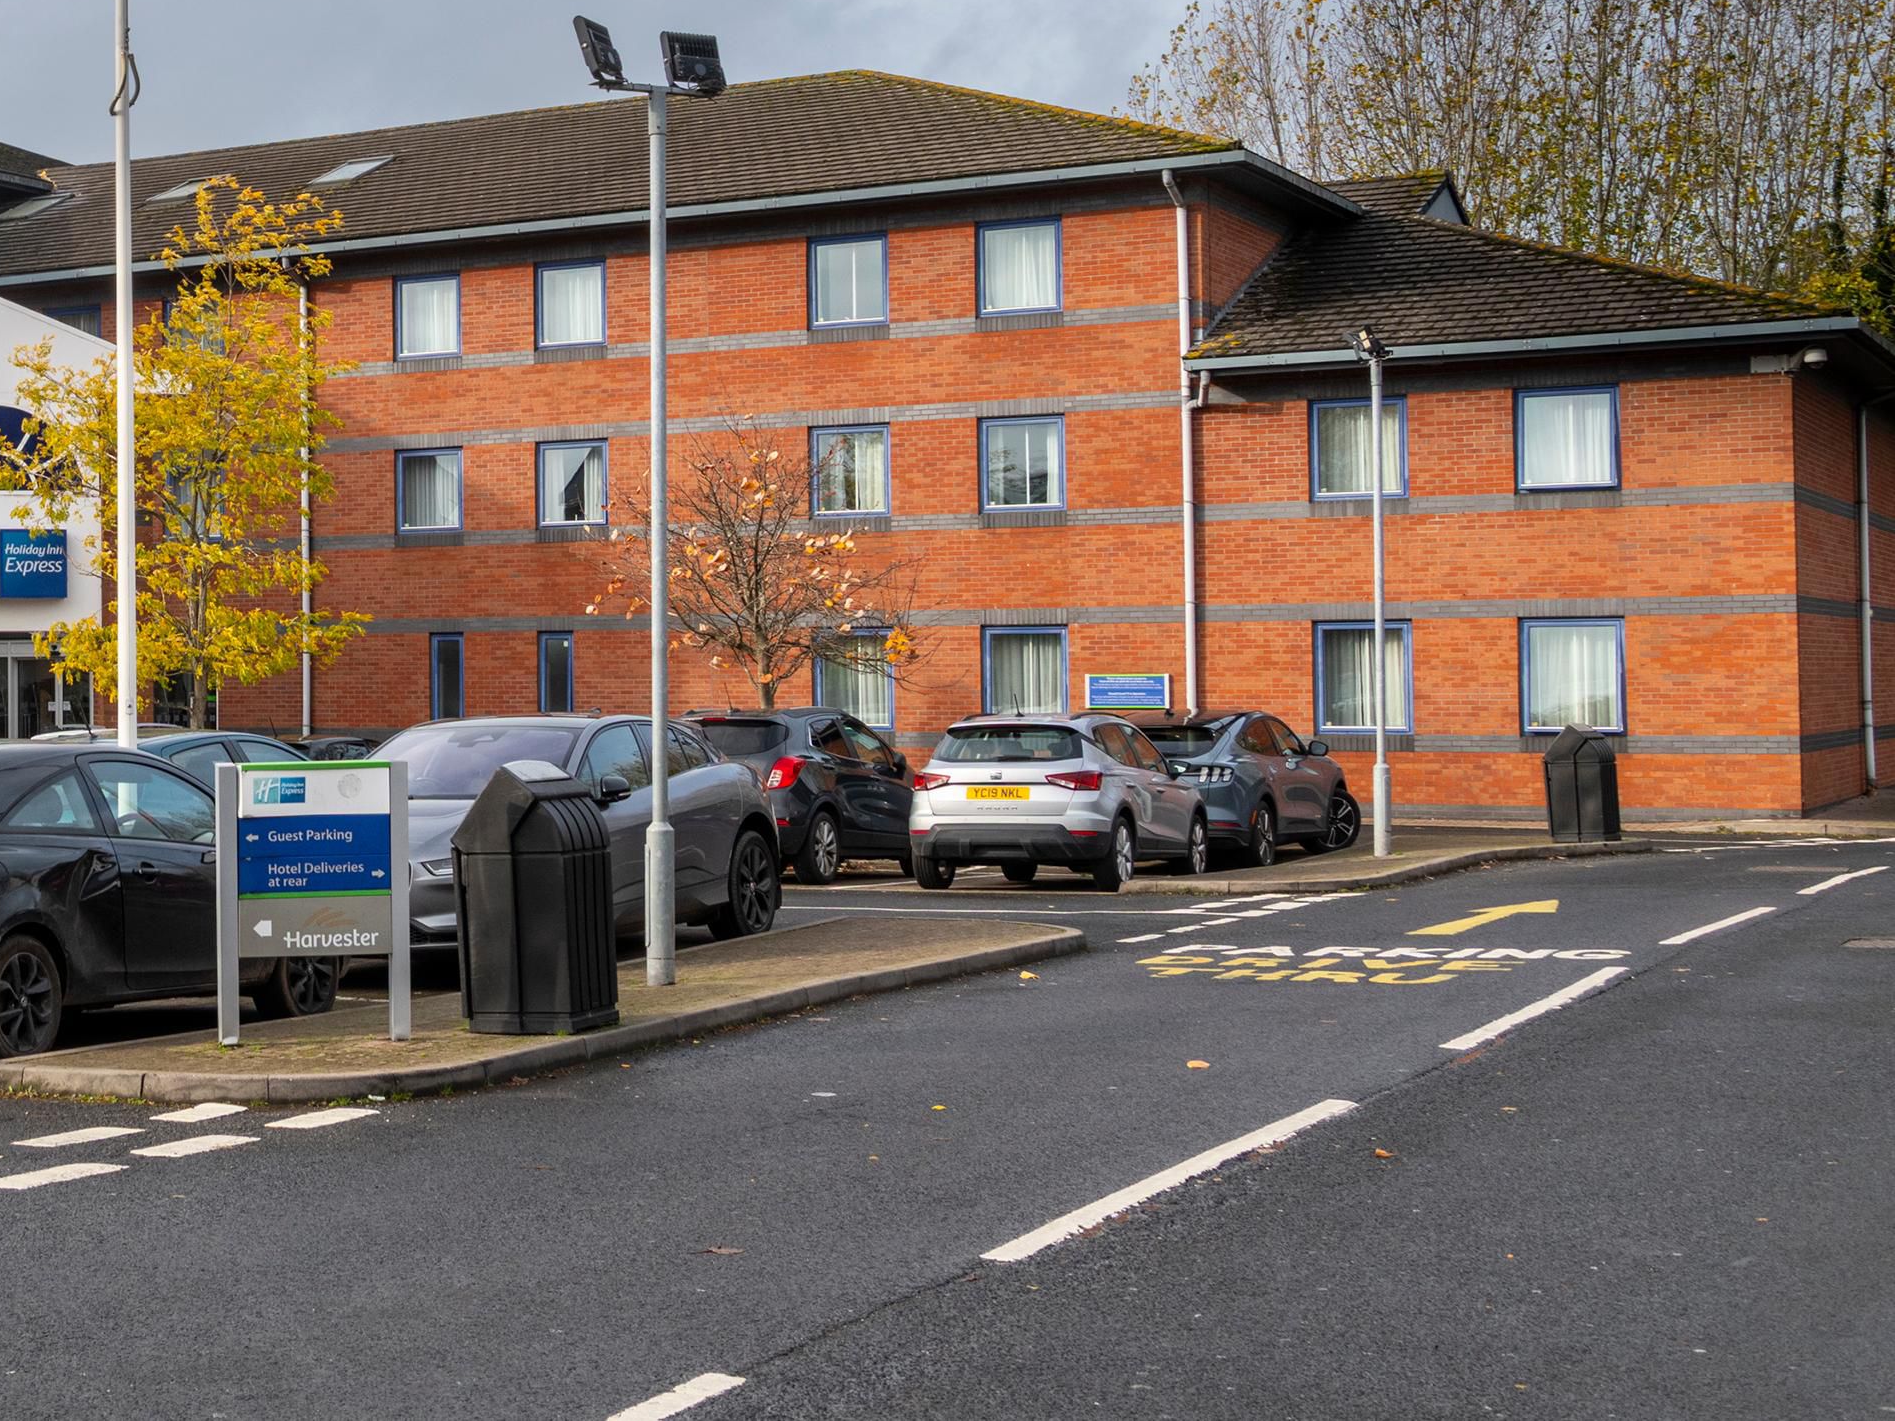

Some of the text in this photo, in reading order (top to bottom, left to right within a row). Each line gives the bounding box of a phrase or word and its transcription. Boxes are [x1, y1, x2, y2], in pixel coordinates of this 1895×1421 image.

[5, 543, 63, 557] Holiday Inn
[5, 557, 63, 576] Express
[281, 787, 305, 796] Express
[974, 788, 1022, 798] YC19 NKL
[268, 829, 353, 843] Guest Parking
[268, 861, 365, 875] Hotel Deliveries
[268, 877, 308, 887] at rear
[283, 929, 379, 948] Harvester
[1162, 944, 1632, 960] PARKING
[1135, 955, 1527, 971] DRIVE
[1146, 967, 1459, 984] THRU
